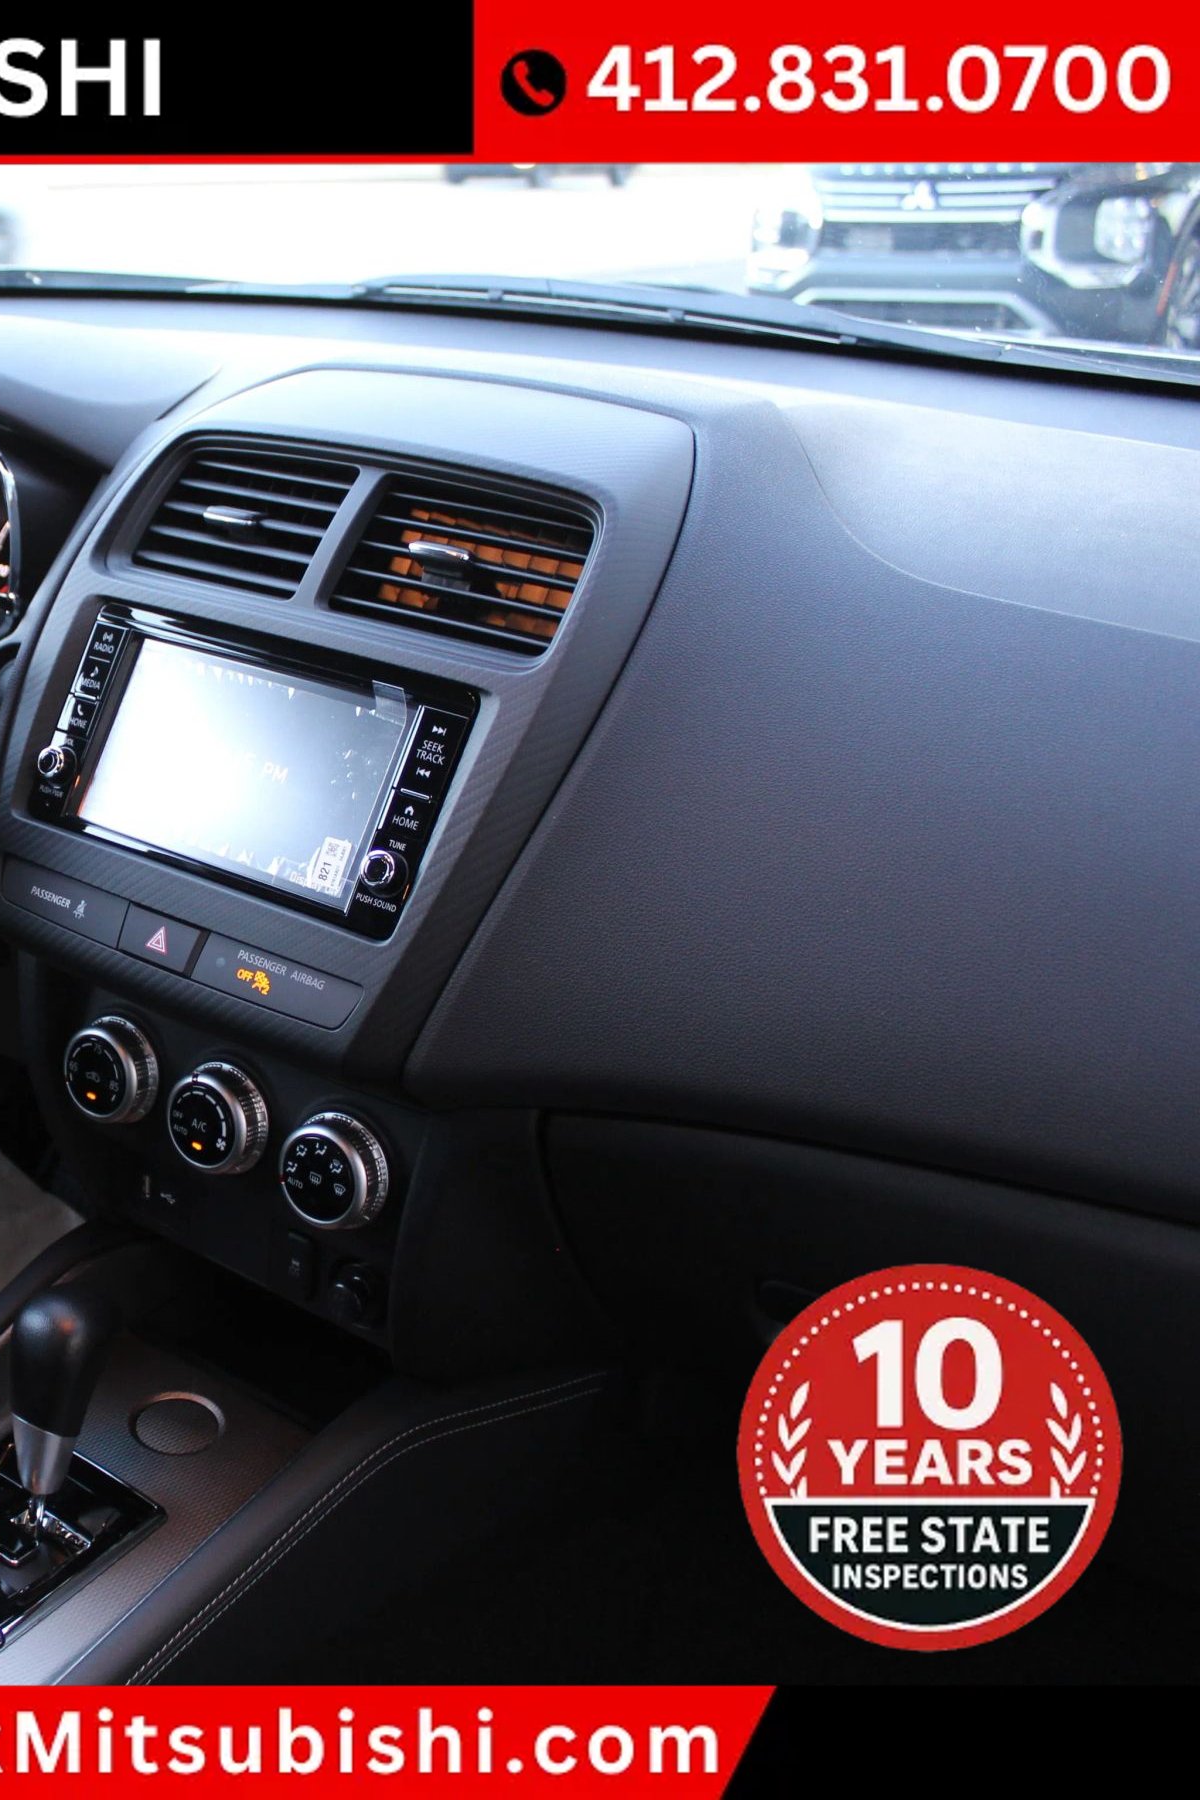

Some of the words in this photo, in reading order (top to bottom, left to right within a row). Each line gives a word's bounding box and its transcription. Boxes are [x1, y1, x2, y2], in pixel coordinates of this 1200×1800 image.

[93, 641, 114, 654] RADIO
[422, 739, 445, 754] SEEK
[416, 748, 445, 766] TRACK
[263, 761, 289, 784] PM
[392, 815, 420, 831] HOME
[389, 839, 407, 852] TUNE
[318, 861, 332, 881] 821
[30, 885, 71, 909] PASSENGER
[355, 891, 373, 905] PUSH
[372, 897, 397, 913] SOUND
[237, 949, 288, 976] PASSENGER
[290, 970, 326, 990] AIRBAG
[237, 968, 254, 982] OFF
[173, 1123, 188, 1136] AUTO
[191, 1118, 207, 1133] A/C
[287, 1176, 303, 1190] AUTO
